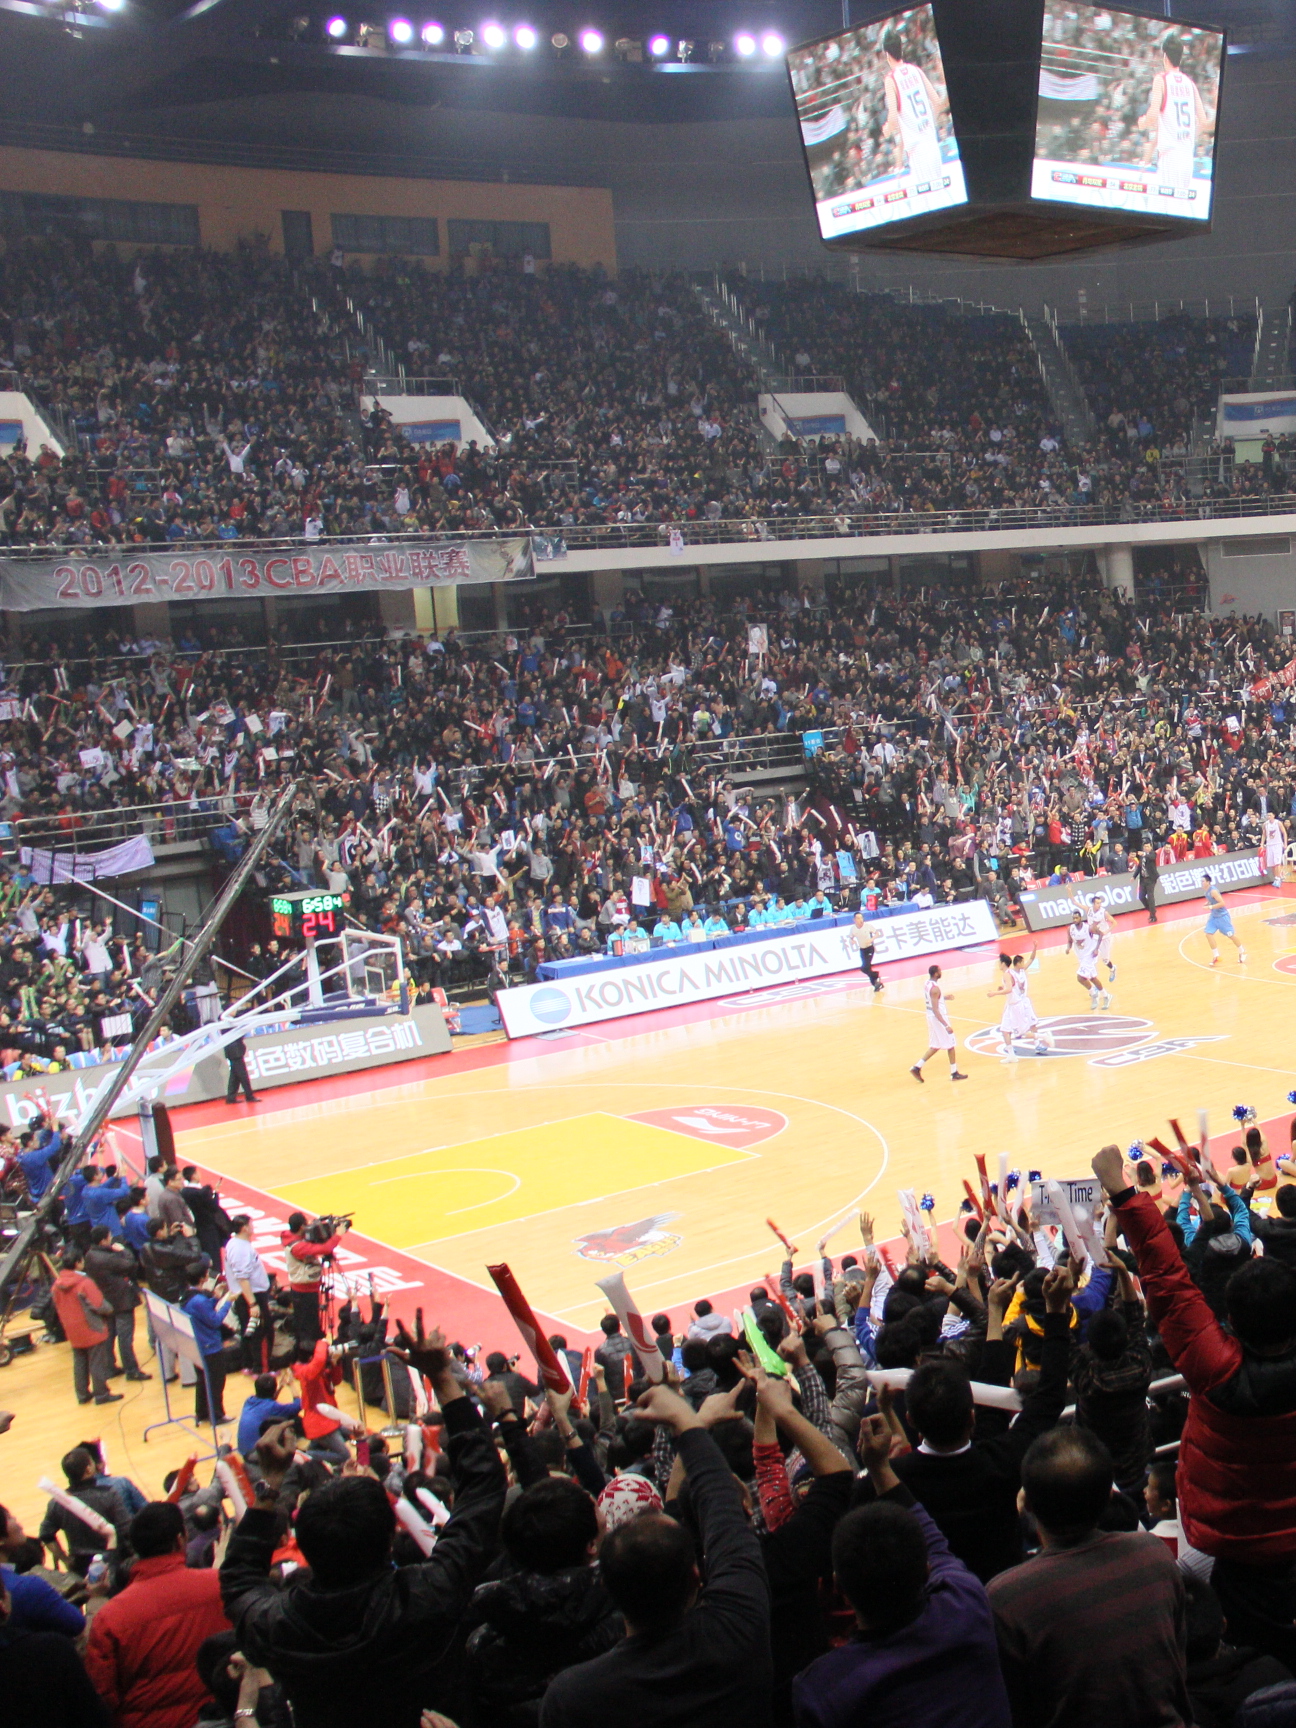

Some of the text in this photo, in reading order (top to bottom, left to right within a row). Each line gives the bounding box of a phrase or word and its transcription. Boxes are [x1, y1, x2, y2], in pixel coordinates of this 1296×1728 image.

[907, 90, 927, 118] 15
[1174, 101, 1191, 128] 15
[53, 548, 471, 599] 2012-2013CBA职业联赛
[273, 911, 335, 938] 24 24
[576, 967, 701, 1013] KONICA
[703, 942, 829, 990] MINOLTA
[1067, 1182, 1093, 1204] Time
